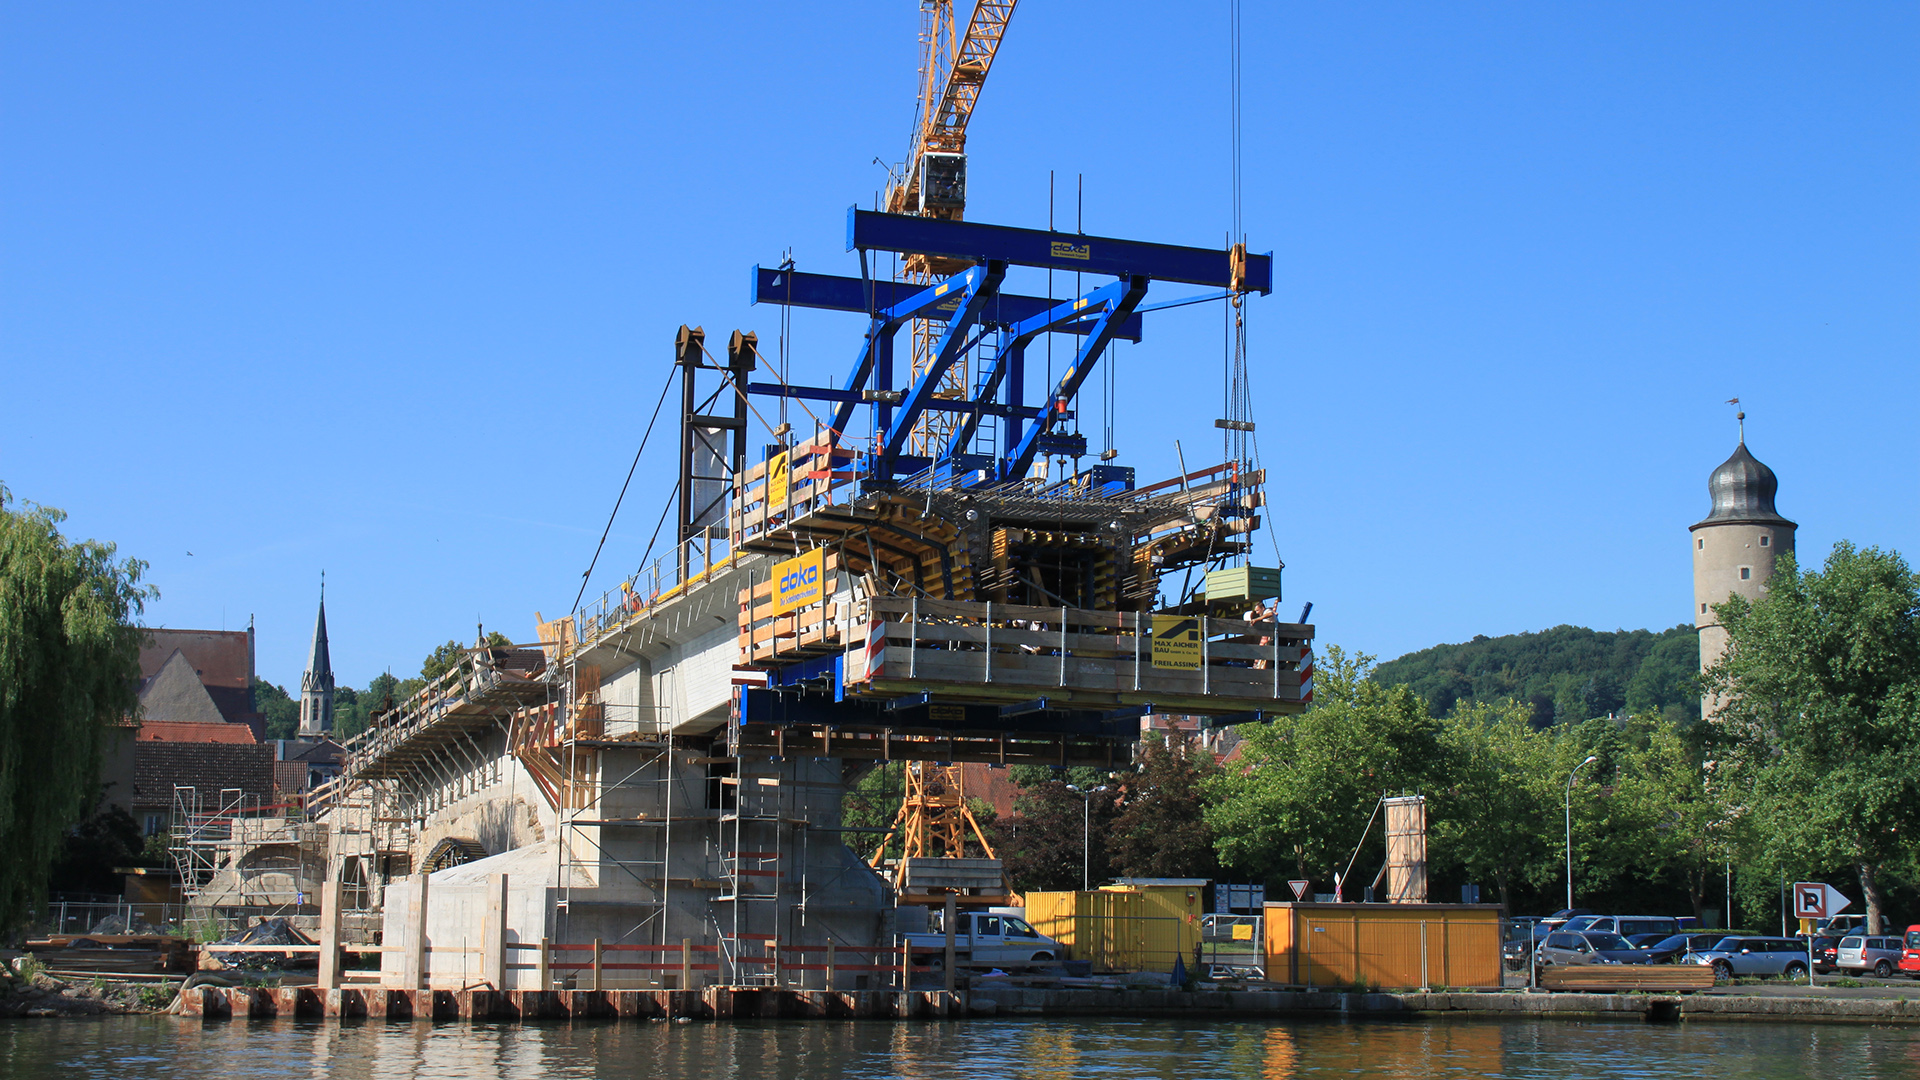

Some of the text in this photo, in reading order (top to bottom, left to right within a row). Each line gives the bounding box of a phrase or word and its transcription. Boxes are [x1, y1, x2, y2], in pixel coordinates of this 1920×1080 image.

[1053, 243, 1088, 253] doka
[780, 563, 817, 594] doka
[1154, 660, 1199, 668] FREILASSING
